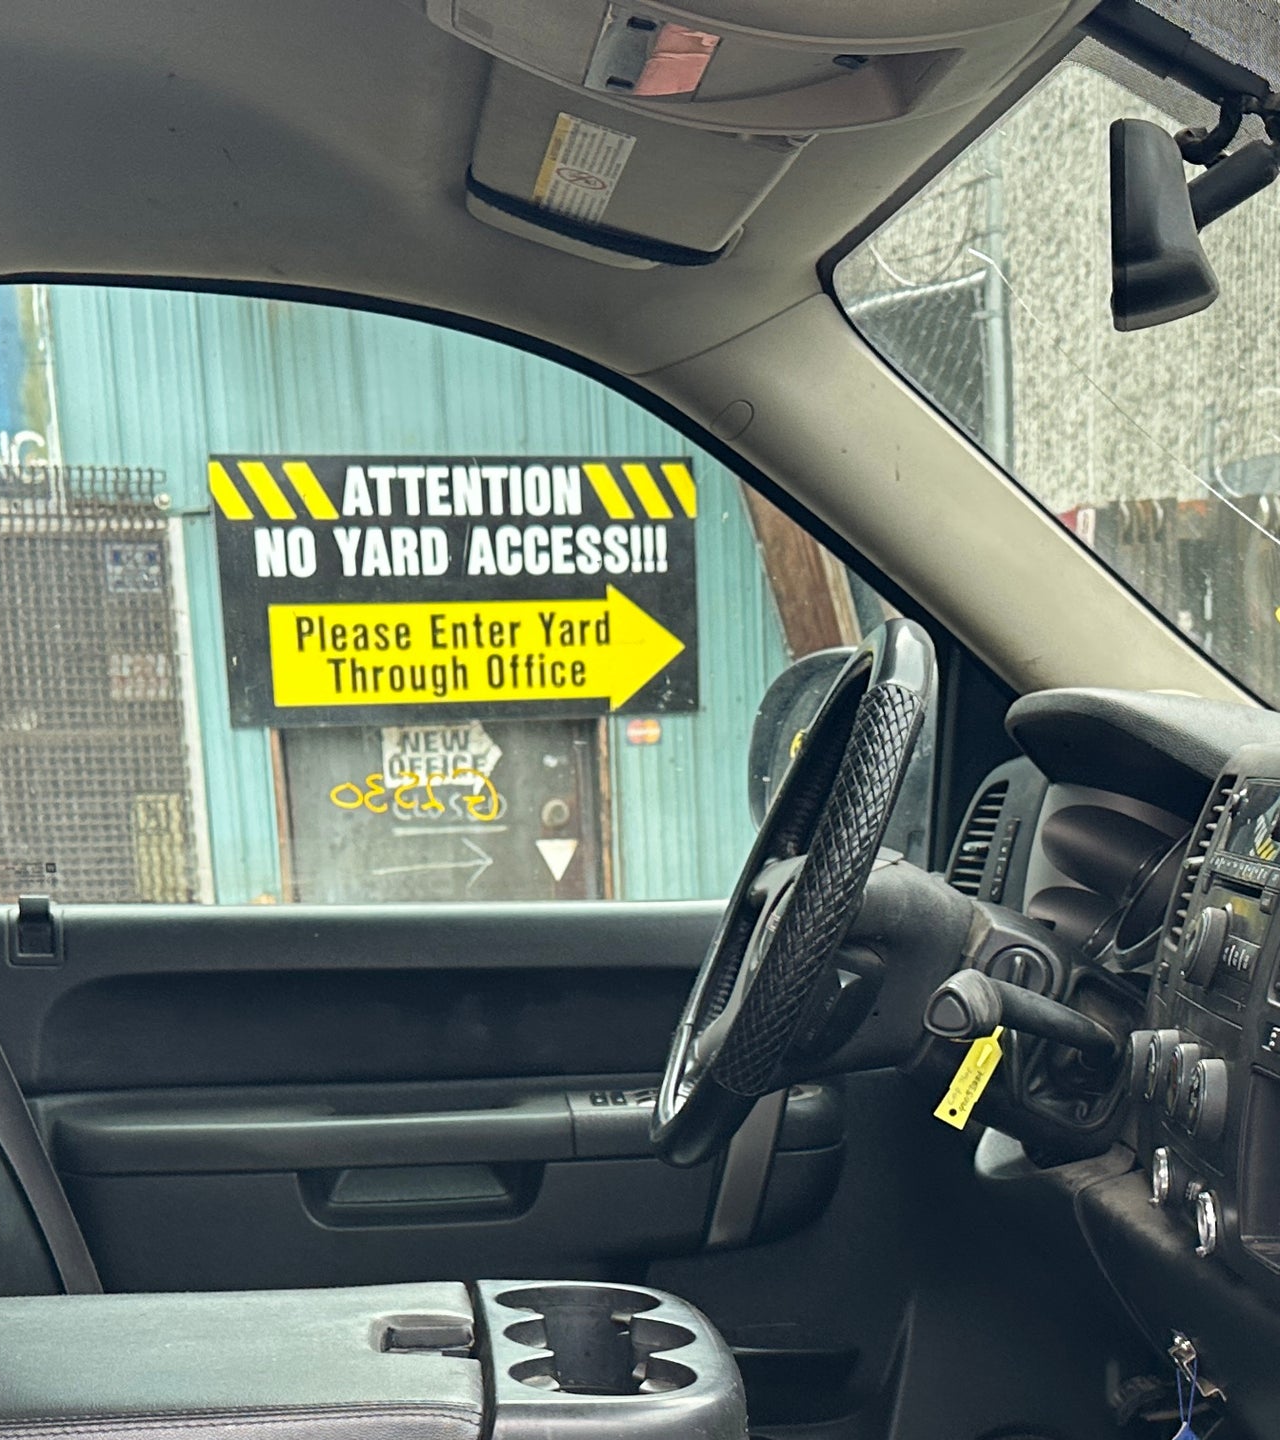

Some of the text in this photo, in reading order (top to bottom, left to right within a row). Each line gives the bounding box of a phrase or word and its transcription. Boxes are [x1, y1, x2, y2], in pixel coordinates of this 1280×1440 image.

[342, 464, 582, 517] ATTENTION
[254, 525, 668, 577] NO YARD ACCESS!!!
[296, 611, 611, 652] Please Enter Yard
[327, 653, 586, 697] Through Office
[400, 731, 471, 752] NEW
